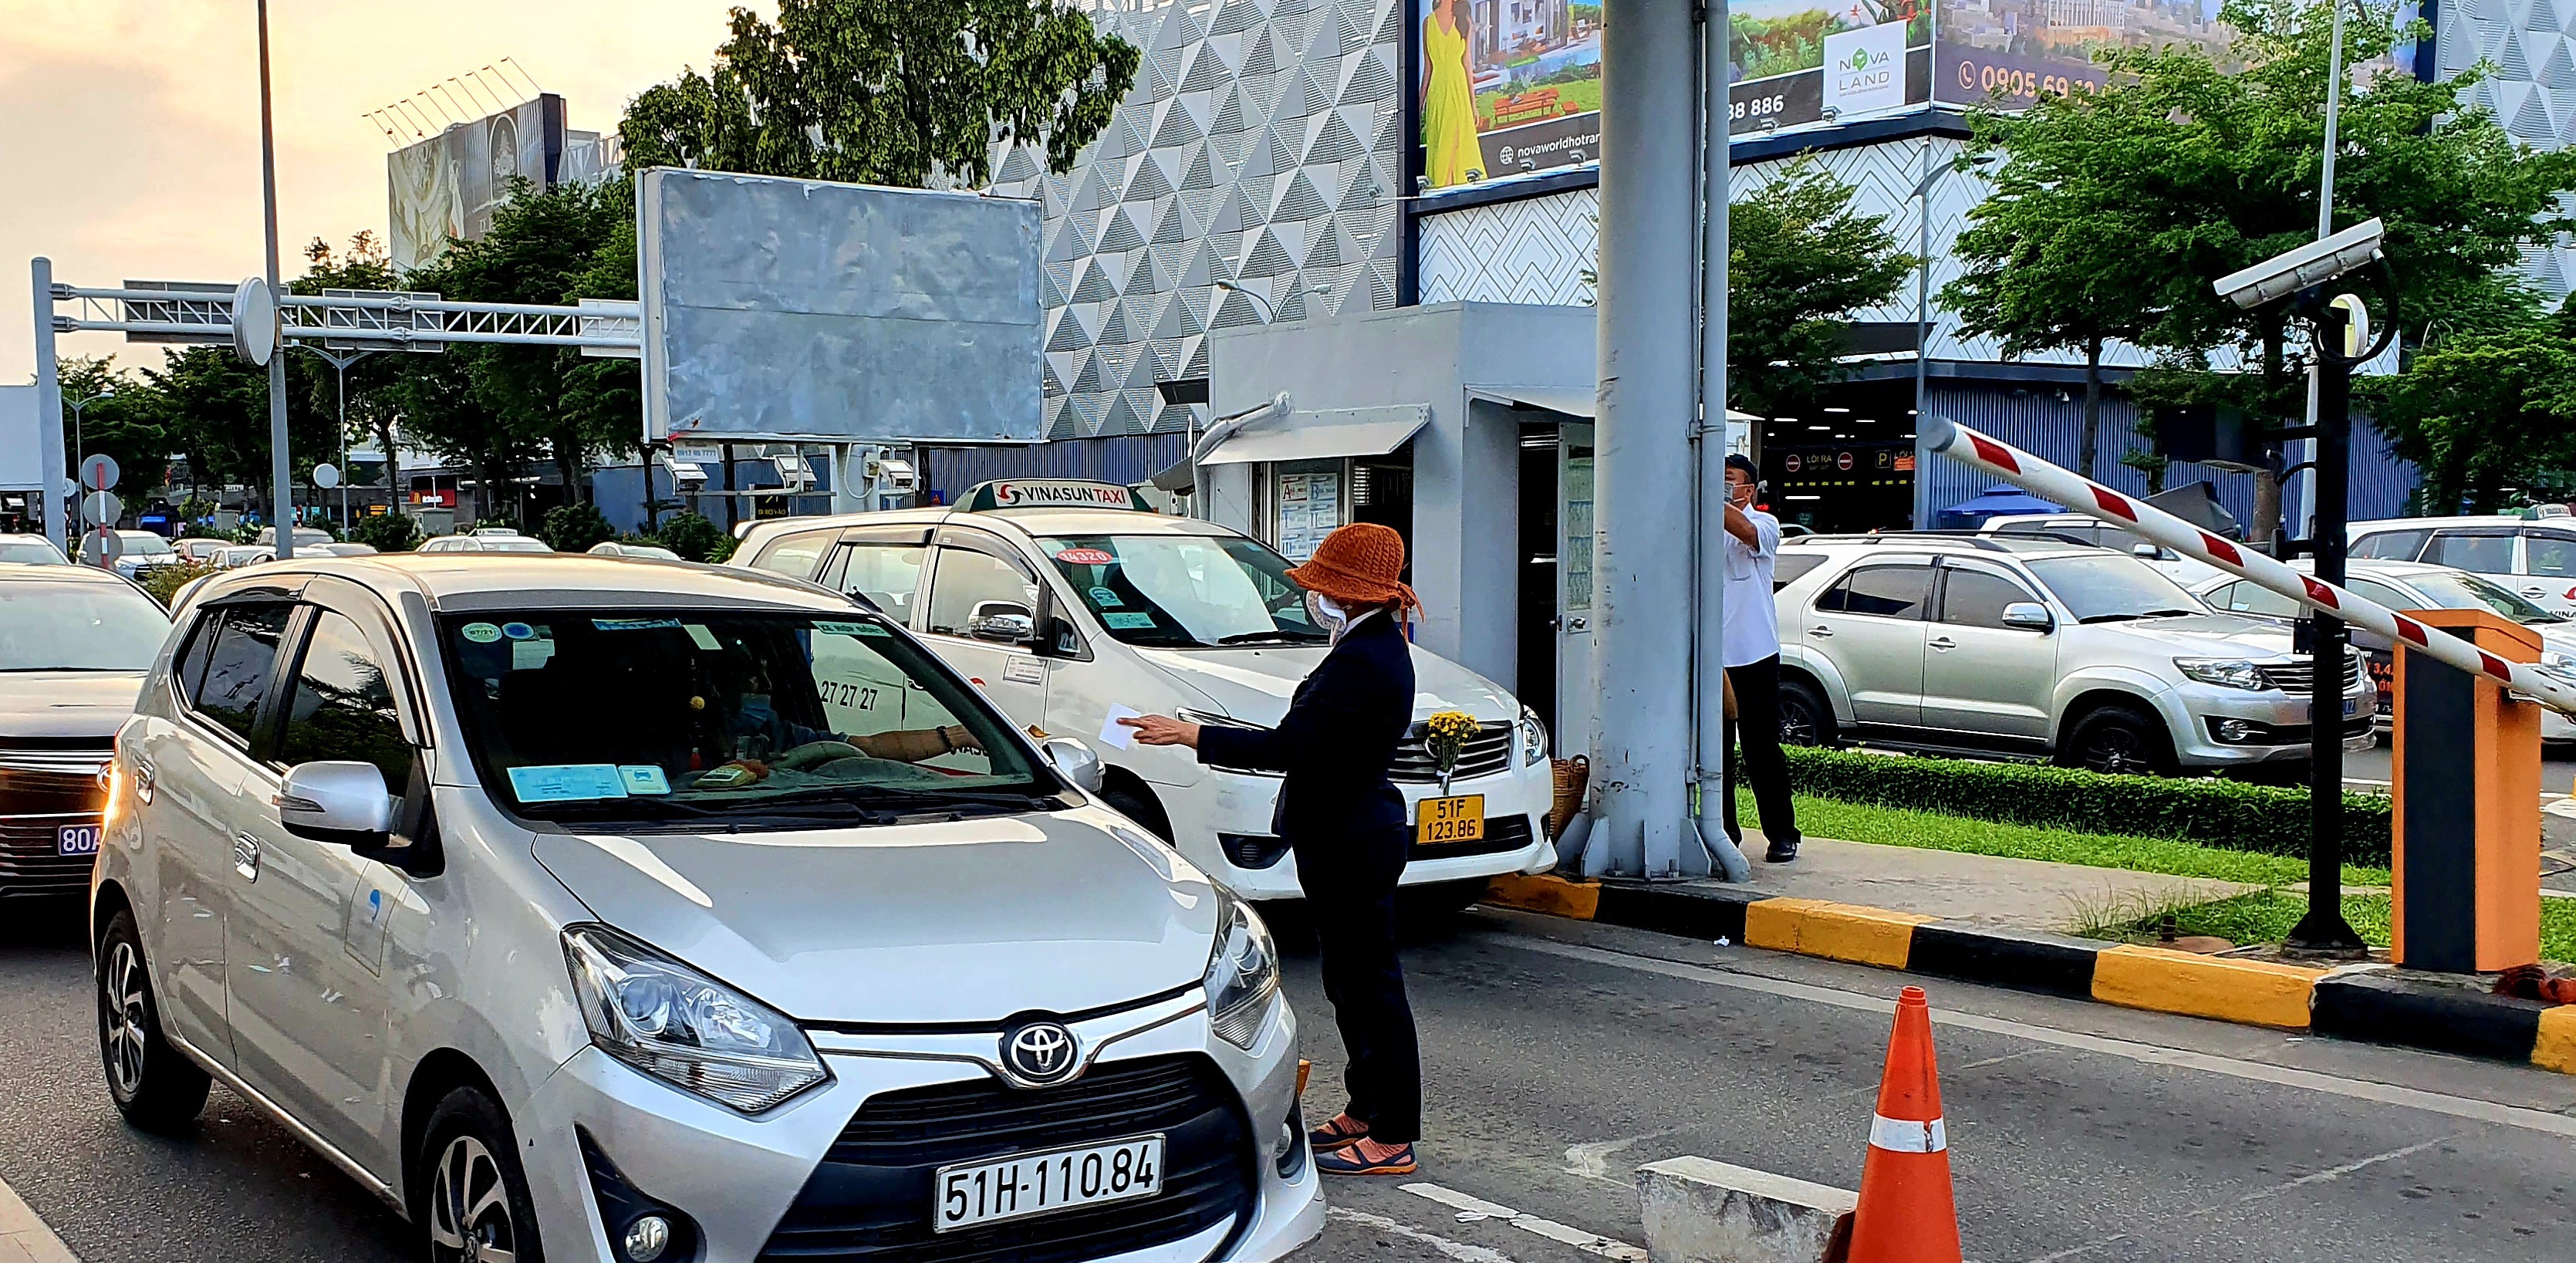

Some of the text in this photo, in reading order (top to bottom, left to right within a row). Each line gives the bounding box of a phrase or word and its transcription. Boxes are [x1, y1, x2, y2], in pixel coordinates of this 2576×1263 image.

[1839, 72, 1889, 91] LAND
[1981, 66, 2036, 98] 0905
[2042, 75, 2068, 100] 69
[1751, 95, 1784, 117] 886
[1518, 133, 1601, 157] novaworldhotra
[821, 680, 878, 711] 27 27 27
[1437, 799, 1466, 819] 51F
[63, 828, 101, 852] 80A
[1426, 819, 1476, 841] 123.86
[945, 1143, 1154, 1221] 51H-110.84
